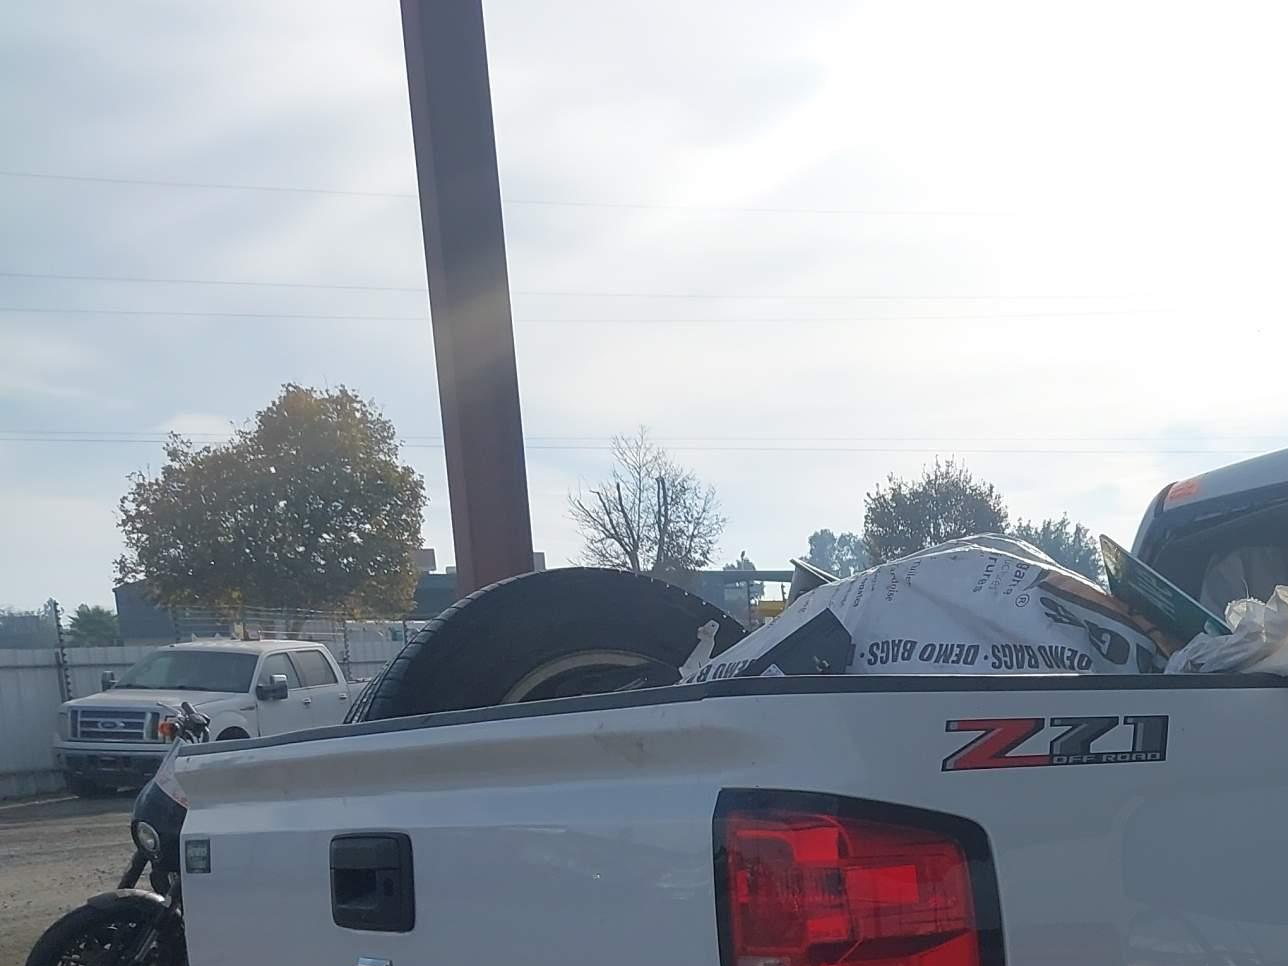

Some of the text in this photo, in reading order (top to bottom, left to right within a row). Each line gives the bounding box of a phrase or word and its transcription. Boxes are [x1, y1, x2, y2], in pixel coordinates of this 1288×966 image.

[867, 639, 918, 666] BAGS
[918, 643, 980, 666] DEMO
[991, 643, 1040, 671] BAGS
[1038, 645, 1093, 671] DEMO
[941, 714, 1169, 772] Z71
[1053, 751, 1162, 765] OFF ROAD
